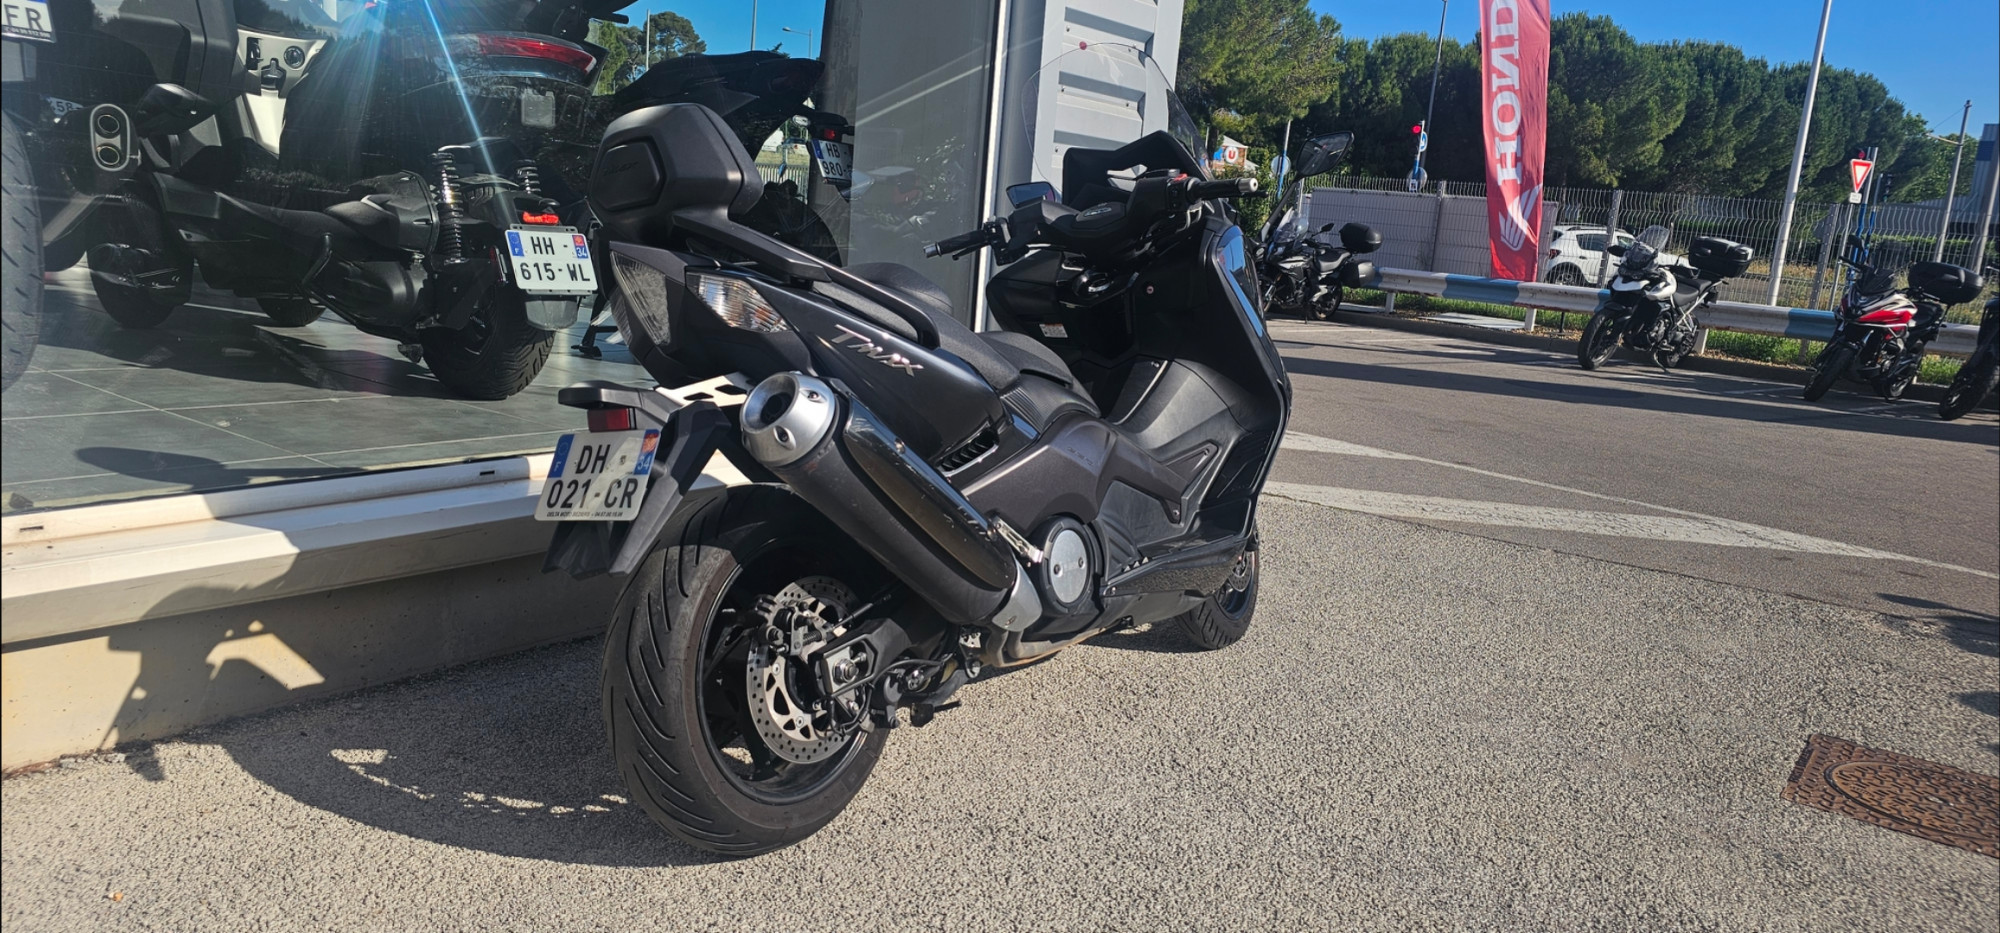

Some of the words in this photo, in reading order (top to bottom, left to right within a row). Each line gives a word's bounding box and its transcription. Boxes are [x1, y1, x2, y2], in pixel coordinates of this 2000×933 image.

[825, 143, 840, 158] HB
[1228, 150, 1236, 160] U
[530, 236, 555, 255] HH
[576, 247, 587, 257] 34
[520, 262, 591, 281] 615-WL
[575, 444, 610, 474] DH
[637, 456, 650, 470] 34
[546, 478, 639, 509] 021-CR
